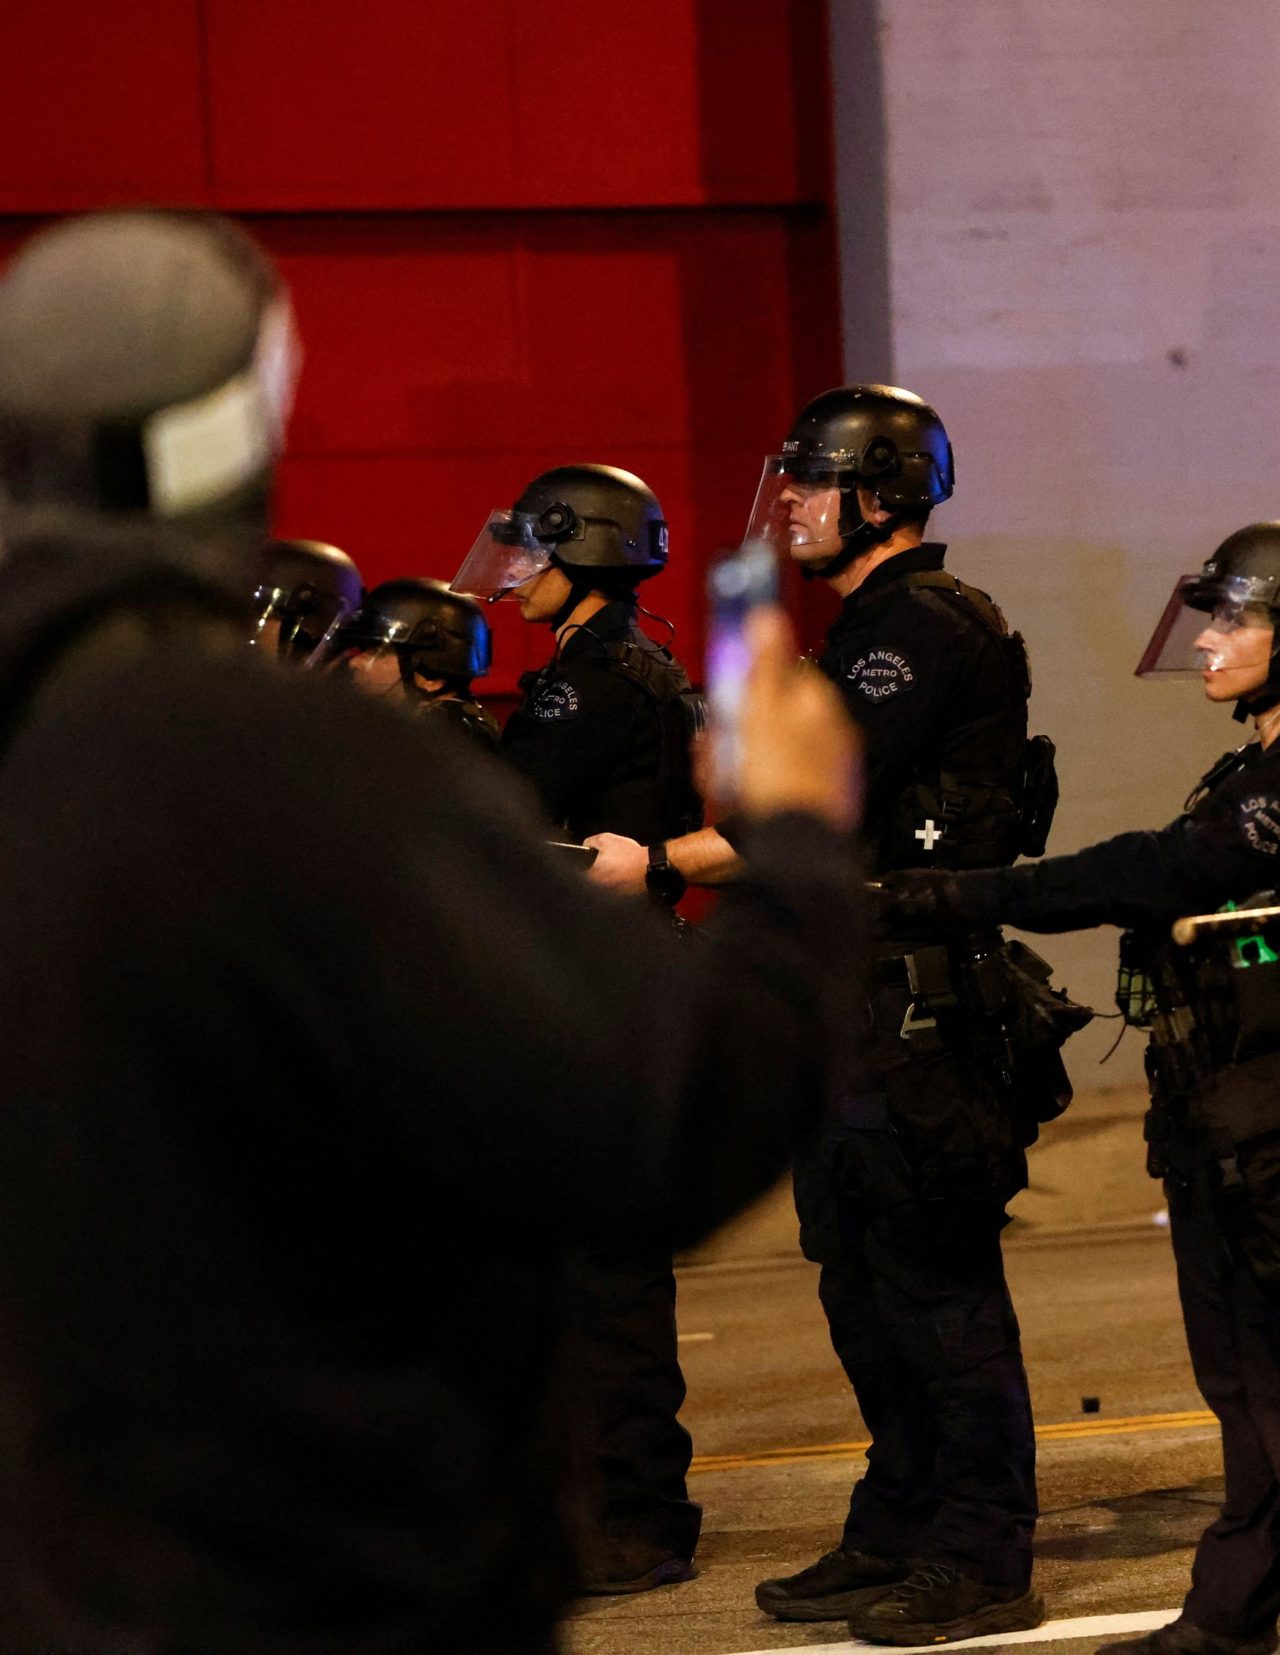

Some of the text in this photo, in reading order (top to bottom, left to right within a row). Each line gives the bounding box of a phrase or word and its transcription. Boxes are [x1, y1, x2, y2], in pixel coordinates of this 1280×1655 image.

[847, 650, 913, 682] LOS ANGELES
[862, 669, 897, 678] METRO
[859, 681, 898, 697] POLICE
[1241, 797, 1266, 813] LOS
